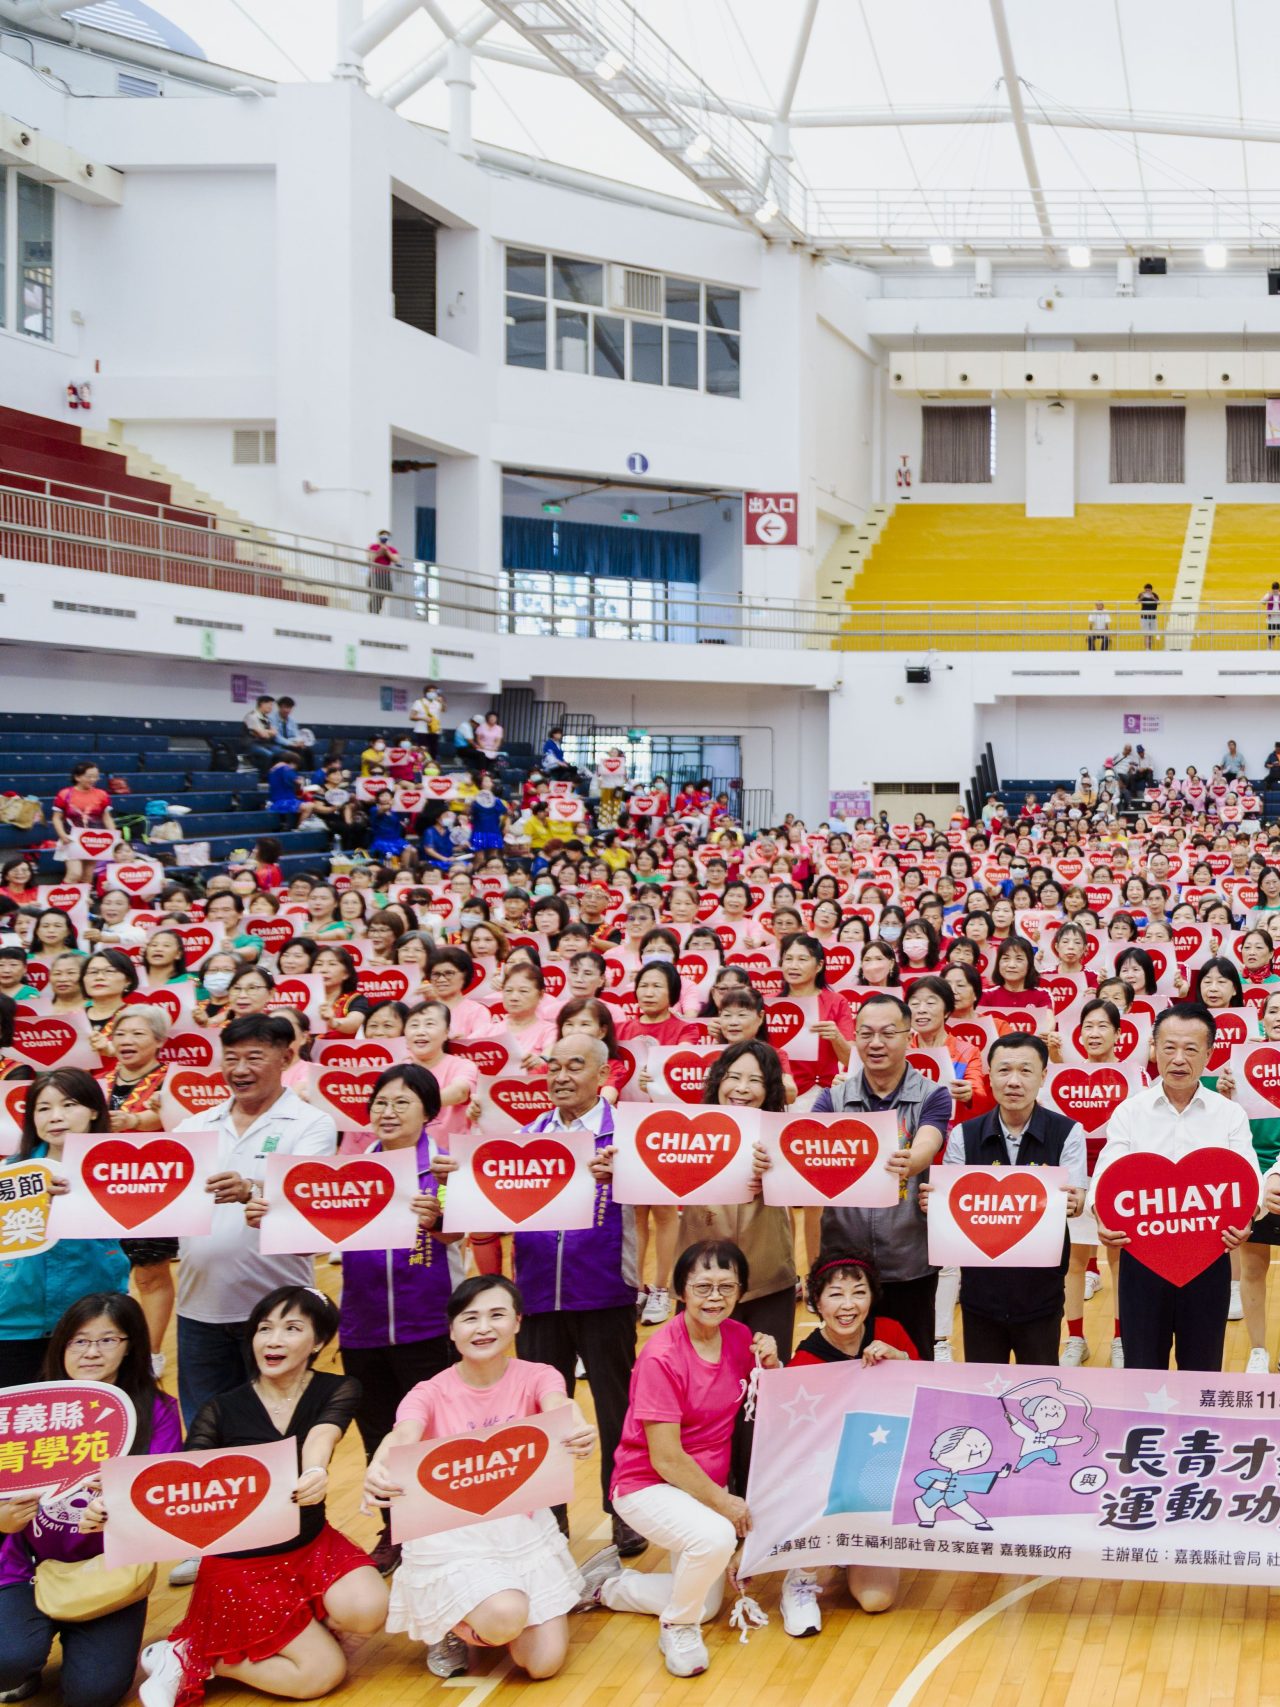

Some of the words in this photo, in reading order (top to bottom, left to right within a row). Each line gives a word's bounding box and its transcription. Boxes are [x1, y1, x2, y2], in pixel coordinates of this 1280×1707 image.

[631, 454, 644, 474] 1
[748, 496, 794, 513] 出入口
[1128, 716, 1136, 728] 9
[1174, 936, 1197, 944] IAYI
[826, 956, 850, 964] IAYI
[676, 965, 703, 974] IAYI
[766, 1014, 798, 1024] IAYI
[1215, 1028, 1240, 1040] AYI
[160, 1047, 206, 1057] HIAYI
[670, 1067, 711, 1081] CHI
[178, 1085, 228, 1097] CHIA
[327, 1084, 373, 1095] CHIA
[1059, 1085, 1120, 1098] CHIAYI
[192, 1096, 228, 1105] COUN
[499, 1092, 545, 1102] CHIA
[646, 1132, 730, 1151] CHIAYI
[790, 1140, 868, 1155] CHIAYI
[658, 1153, 714, 1163] COUNTY
[805, 1157, 856, 1166] COUNTY
[93, 1162, 183, 1181] CHIAYI
[483, 1159, 565, 1177] CHIAYI
[107, 1183, 167, 1194] COUNTY
[295, 1180, 384, 1198] CHIAYI
[495, 1179, 551, 1189] COUNTY
[312, 1198, 369, 1209] COUNTY
[959, 1194, 1039, 1211] CHIAYI
[1114, 1182, 1240, 1216] CHIAYI
[2, 1206, 45, 1245] 樂
[970, 1215, 1022, 1224] COUNTY
[1136, 1215, 1220, 1236] COUNTY
[432, 1442, 535, 1482] CHIAYI
[449, 1466, 518, 1489] COUNTY
[1080, 1473, 1097, 1486] 與
[146, 1476, 256, 1504] CHIAYI
[165, 1499, 237, 1516] COUNTY
[1000, 1544, 1072, 1560] 嘉義縣政府
